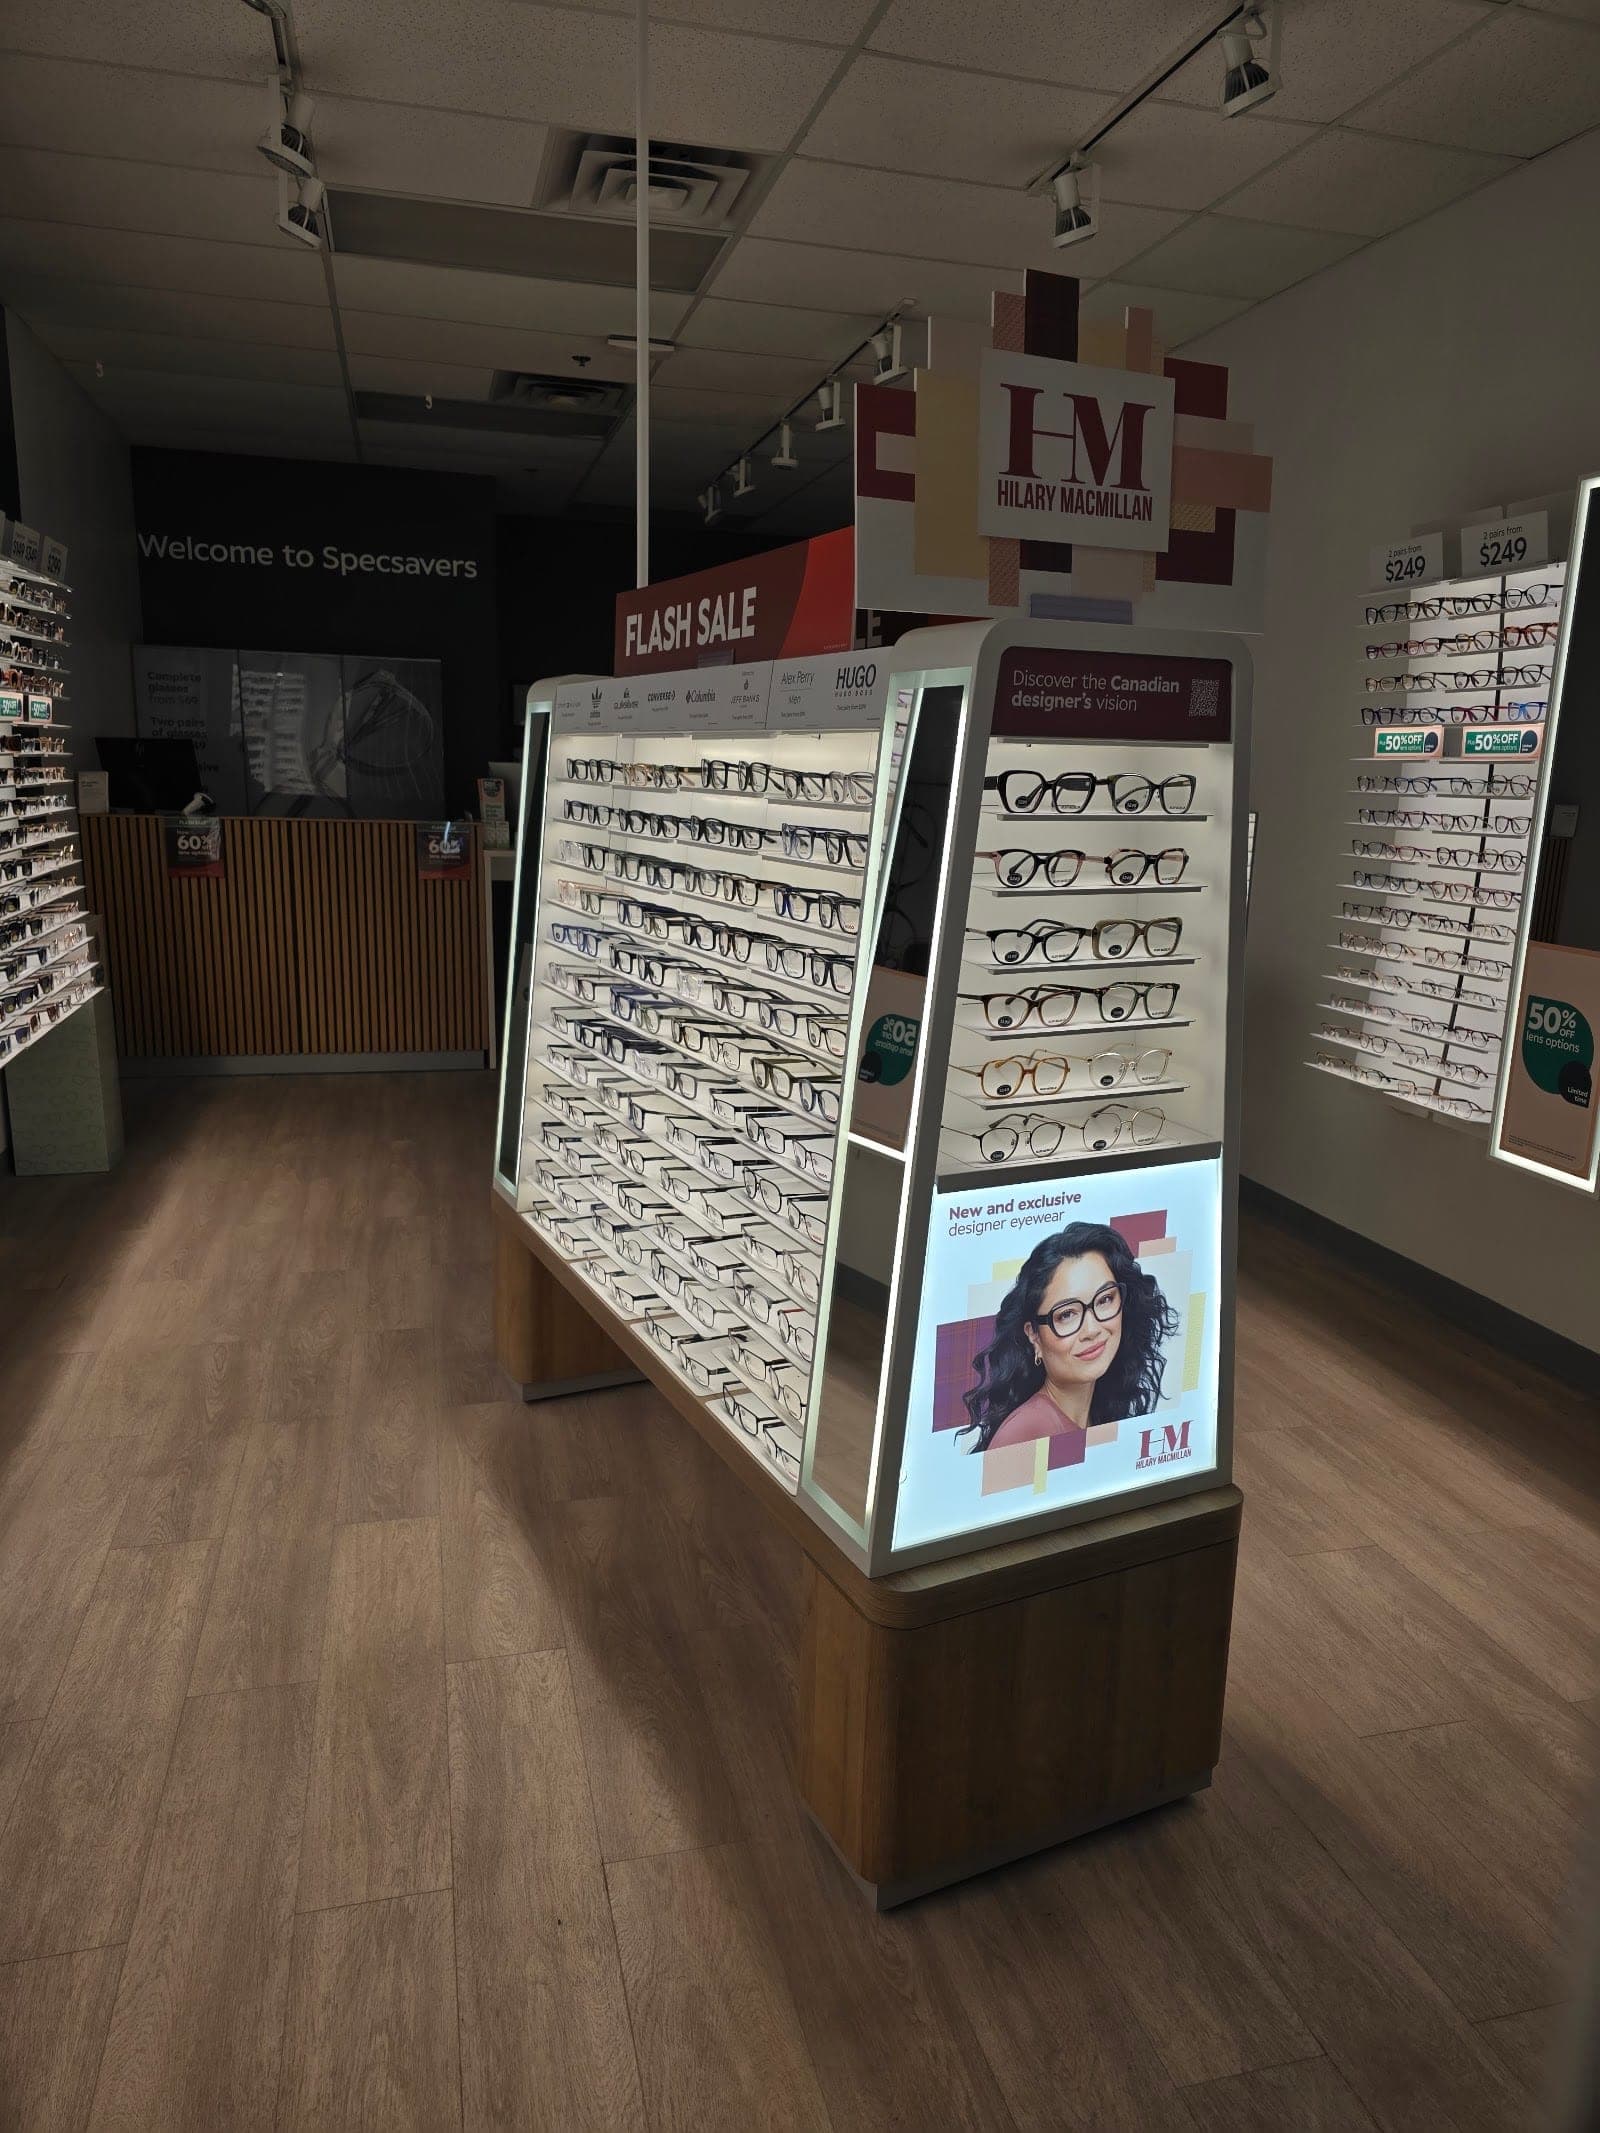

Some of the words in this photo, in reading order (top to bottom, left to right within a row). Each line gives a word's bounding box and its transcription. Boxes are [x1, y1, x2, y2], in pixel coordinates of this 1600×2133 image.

[997, 479, 1056, 512] HILARY
[1060, 486, 1153, 521] MACMILLAN
[1488, 528, 1505, 540] pairs
[1506, 525, 1523, 536] from
[137, 533, 274, 566] Welcome
[281, 544, 314, 568] to
[322, 546, 478, 578] Specsavers
[1480, 537, 1527, 567] $249
[1386, 556, 1425, 582] $249
[625, 601, 692, 657] FLASH
[696, 586, 757, 646] SALE
[782, 672, 797, 685] Alex
[797, 670, 815, 687] Perry
[835, 663, 877, 690] HUGO
[1013, 670, 1077, 689] Discover
[1082, 672, 1106, 690] the
[1110, 675, 1179, 693] Canadian
[1011, 690, 1092, 711] designer's
[1097, 694, 1138, 711] vision
[1527, 1002, 1576, 1034] 50%
[1525, 1030, 1544, 1044] lens
[1545, 1037, 1580, 1054] options
[1559, 1028, 1575, 1039] OFF
[949, 1205, 983, 1220] New
[986, 1199, 1015, 1215] and
[1018, 1192, 1082, 1211] exclusive
[948, 1220, 1007, 1237] designer
[1010, 1210, 1065, 1230] eyewear
